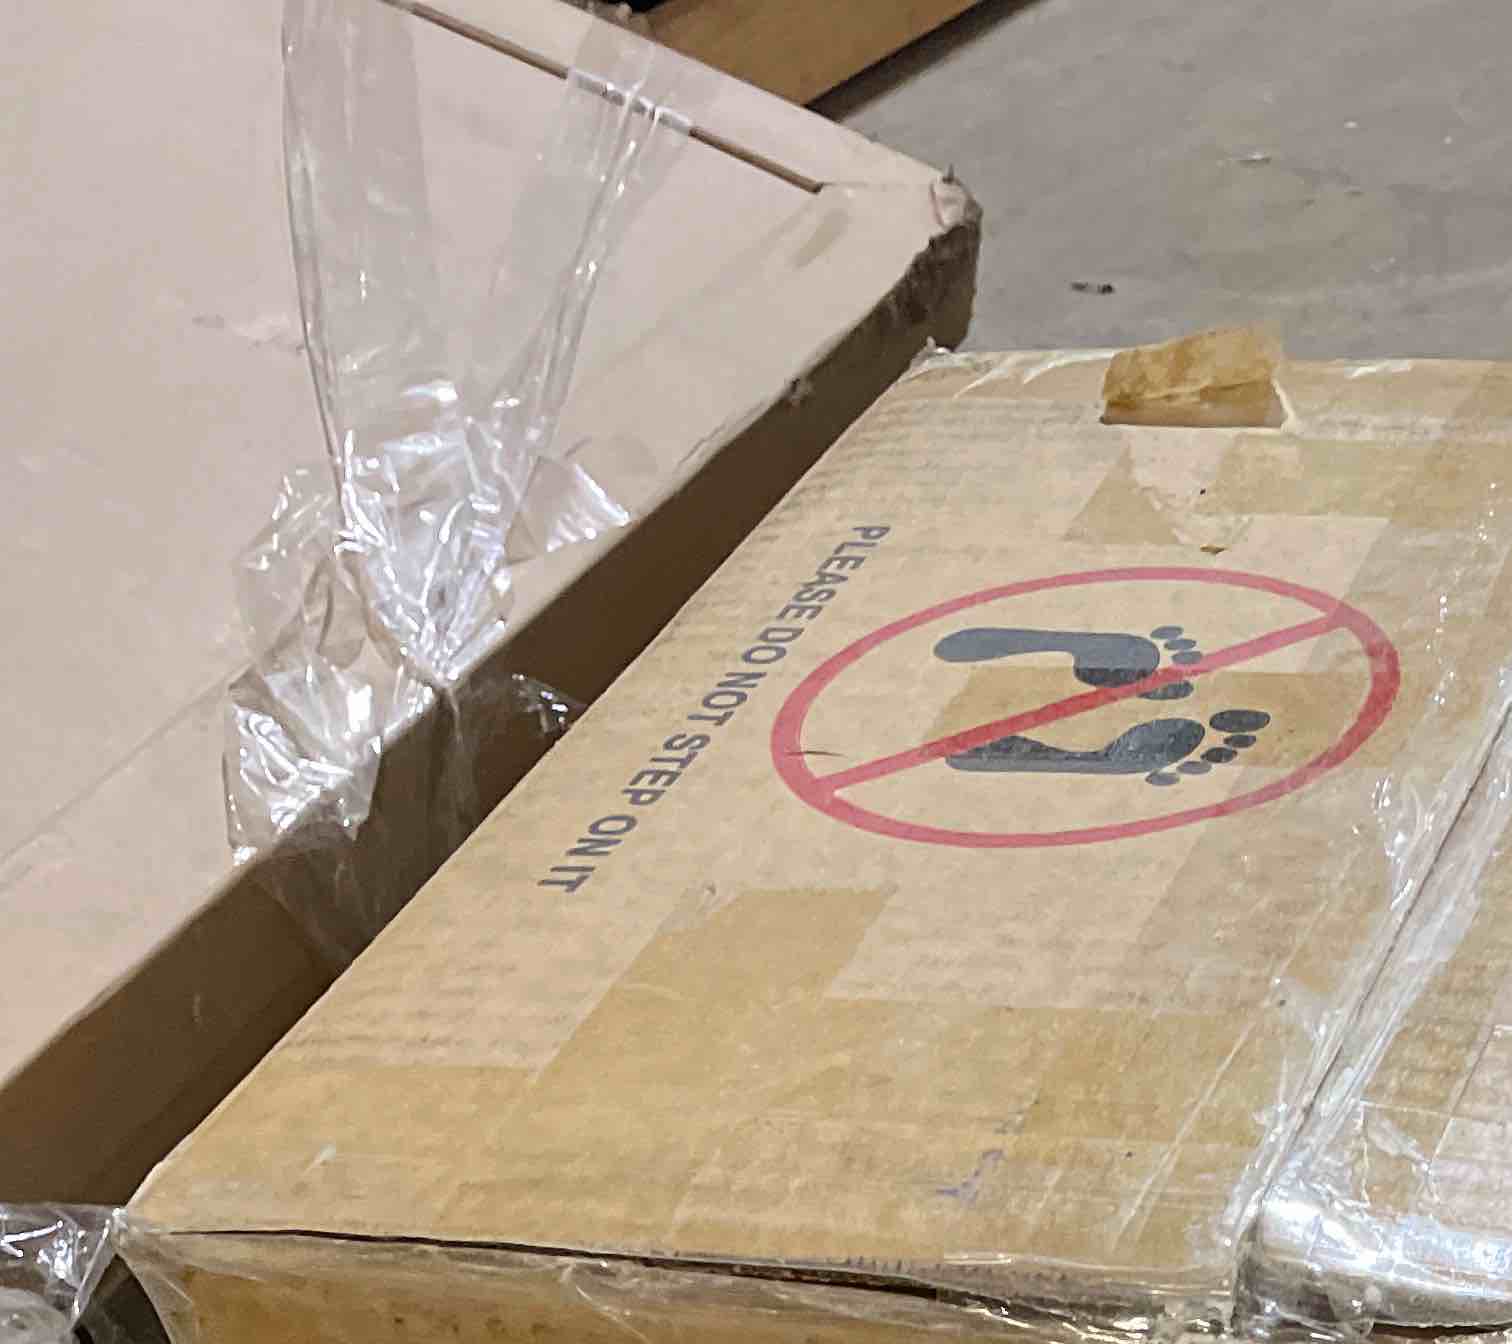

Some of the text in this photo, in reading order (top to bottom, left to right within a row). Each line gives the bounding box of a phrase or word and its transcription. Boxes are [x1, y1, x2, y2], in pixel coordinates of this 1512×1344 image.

[537, 525, 891, 893] PLEASE DO NOT STEP ON IT
